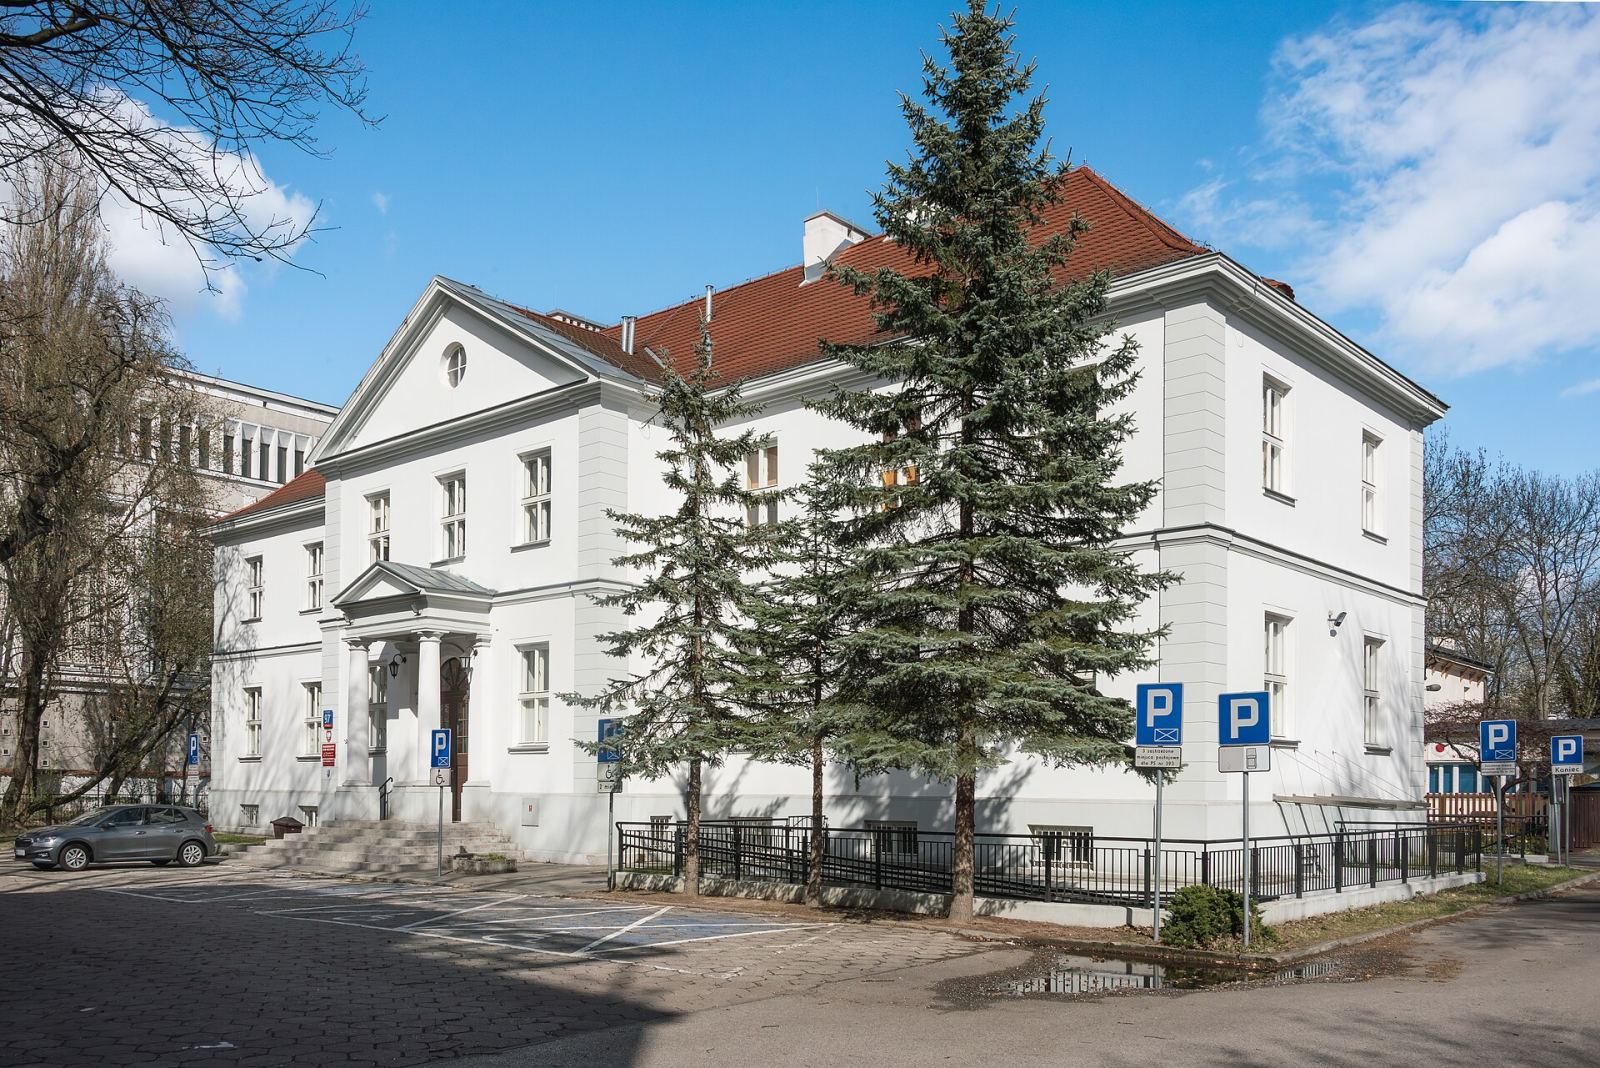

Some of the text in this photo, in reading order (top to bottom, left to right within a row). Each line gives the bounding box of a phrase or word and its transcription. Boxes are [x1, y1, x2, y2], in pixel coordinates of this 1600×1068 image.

[1147, 689, 1173, 727] P
[1230, 698, 1259, 739] P
[190, 736, 197, 756] P
[435, 732, 447, 757] P
[1488, 724, 1509, 750] P
[1558, 739, 1576, 761] P
